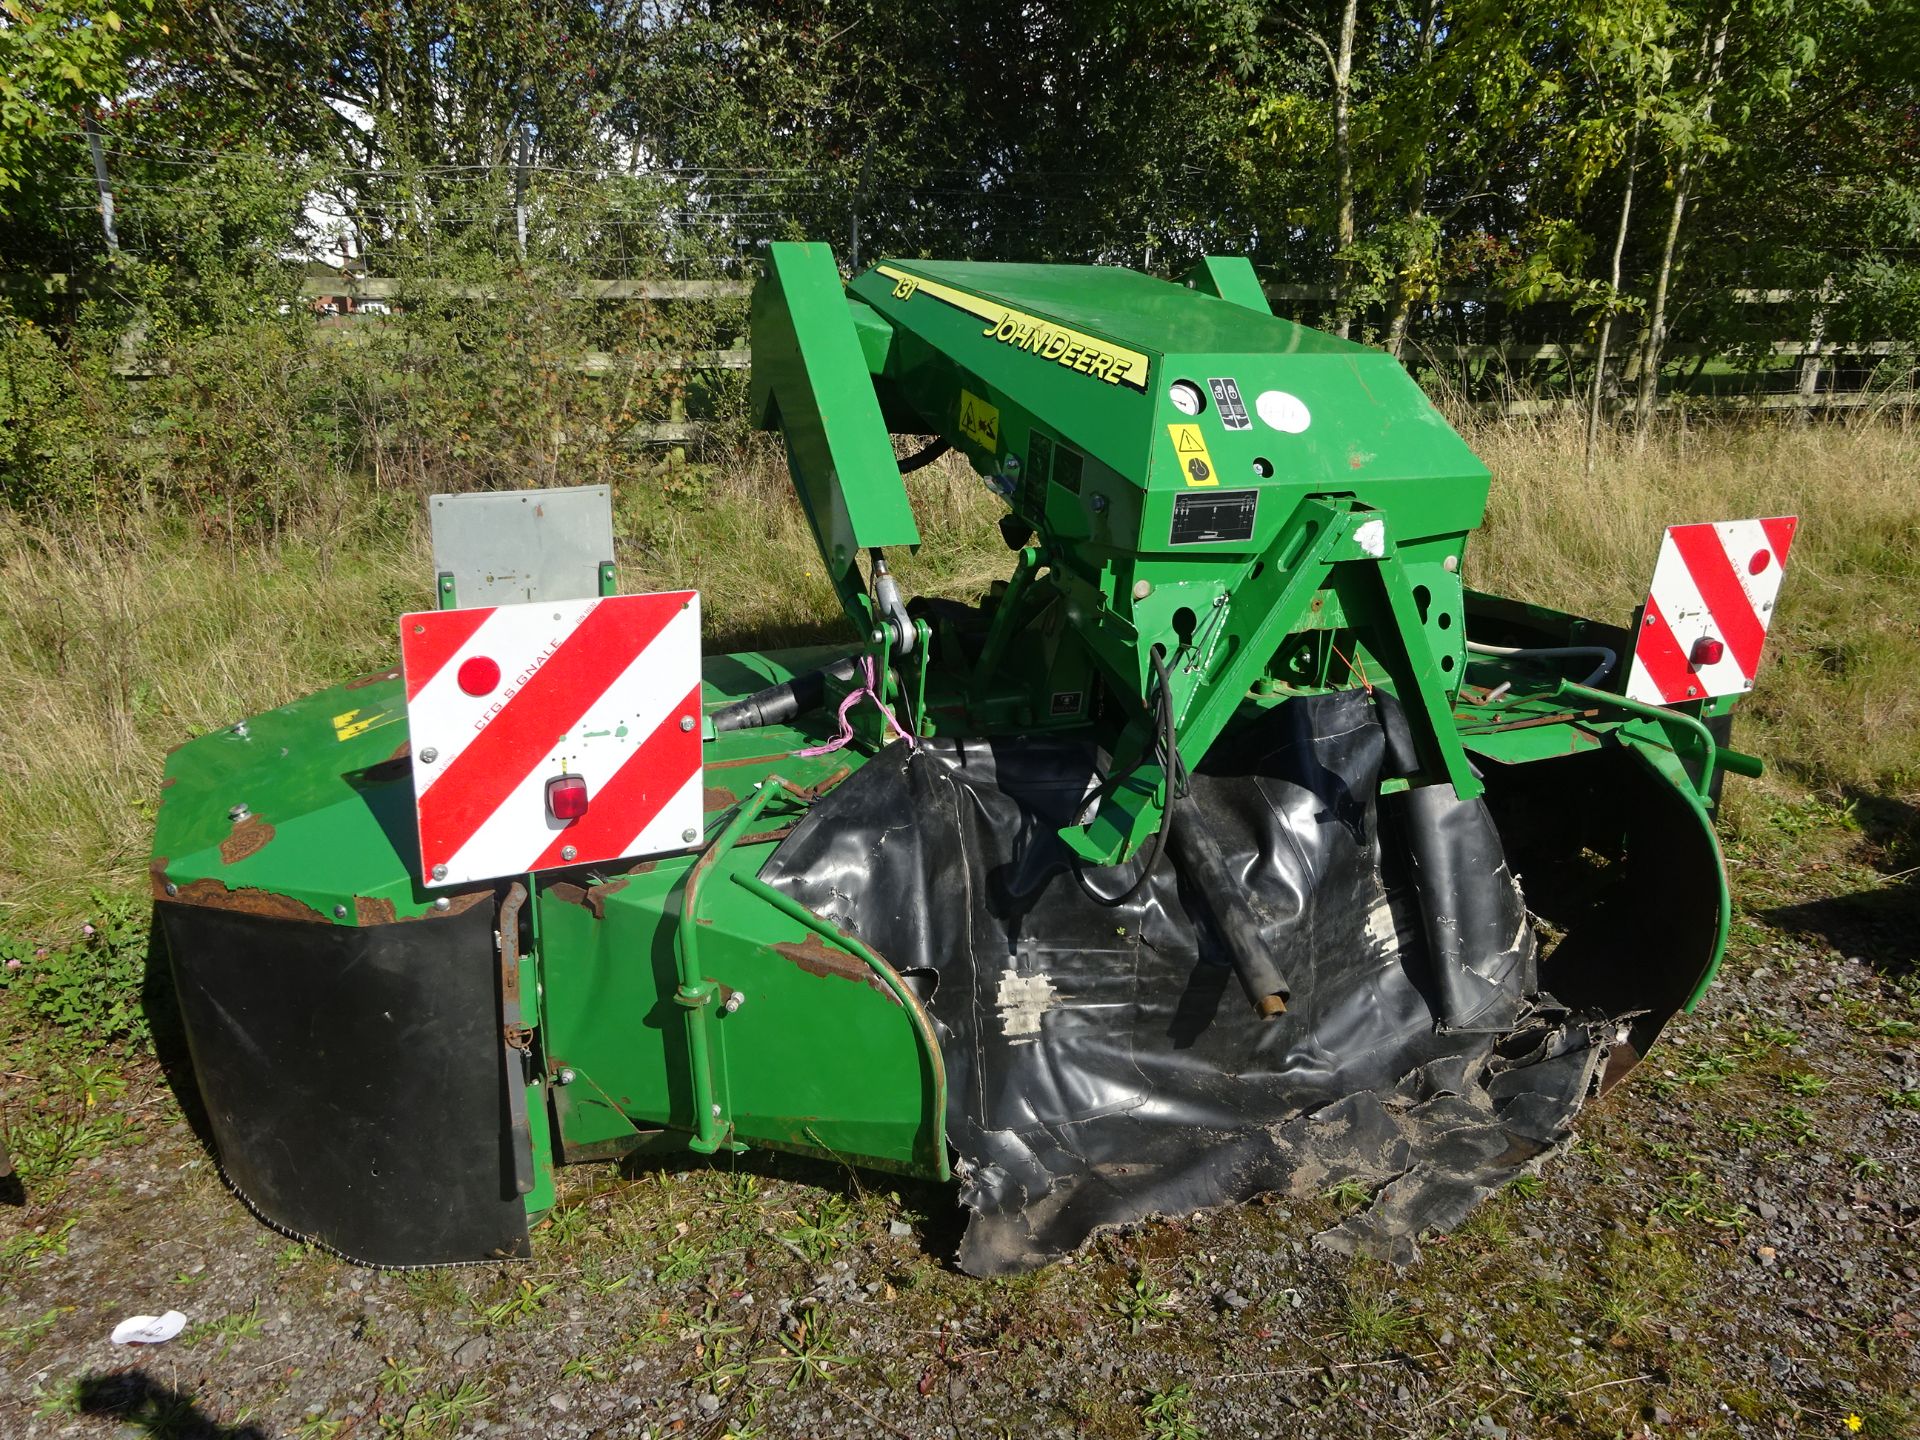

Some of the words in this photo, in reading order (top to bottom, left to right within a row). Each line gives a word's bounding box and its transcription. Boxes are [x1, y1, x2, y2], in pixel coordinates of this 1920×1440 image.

[892, 278, 919, 301] 131
[982, 312, 1051, 355] JOHN
[1039, 331, 1133, 385] DEERE
[474, 702, 503, 731] CFG
[504, 638, 561, 699] SGNALE
